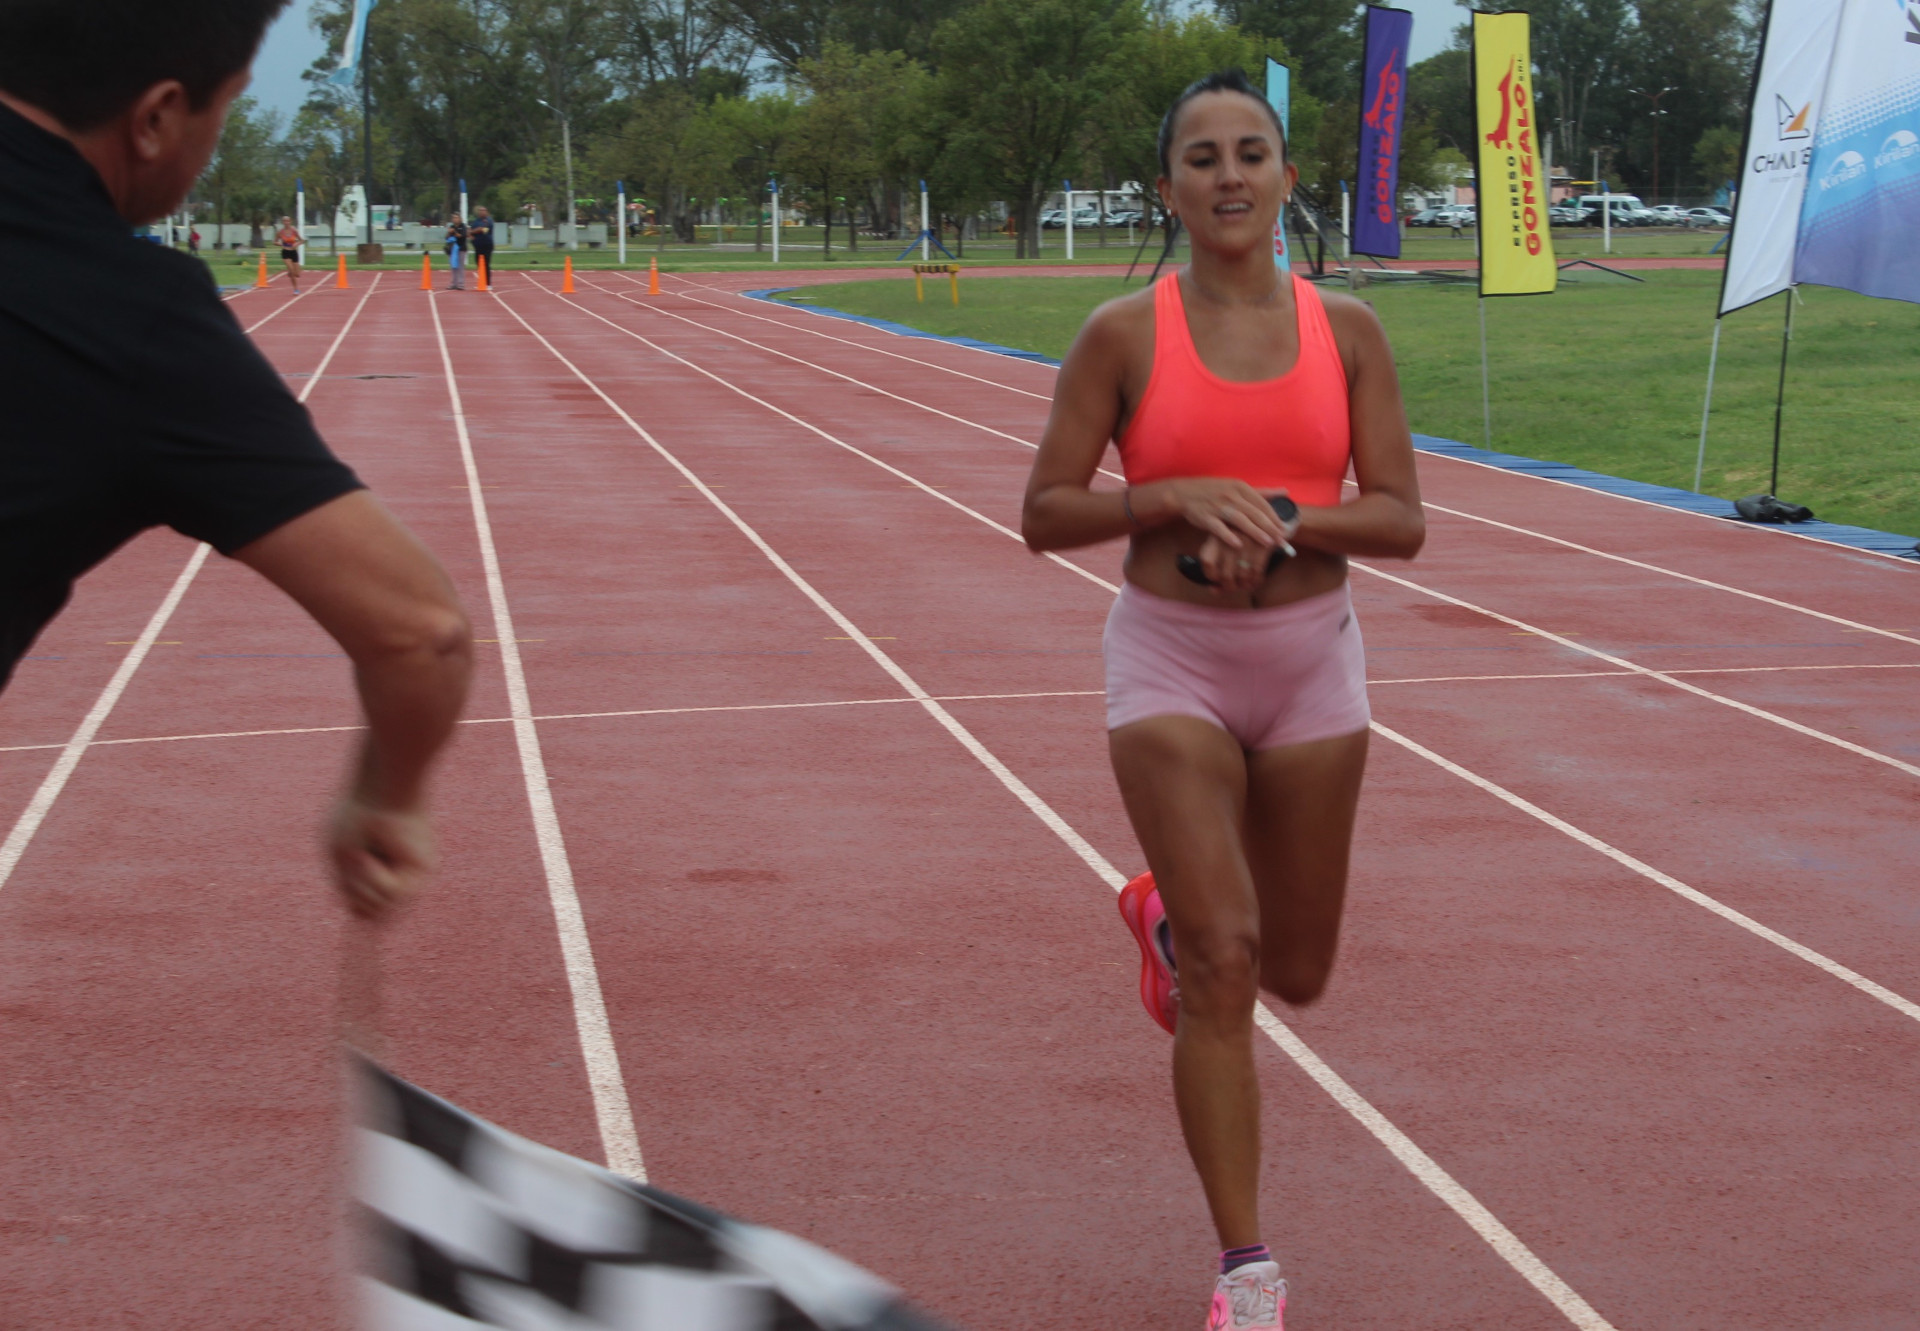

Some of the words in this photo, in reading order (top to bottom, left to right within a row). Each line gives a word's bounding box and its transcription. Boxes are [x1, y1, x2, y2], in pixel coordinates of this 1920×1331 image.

[1376, 72, 1400, 223] GONZALO
[1506, 155, 1521, 247] EXPRESO
[1514, 83, 1543, 256] GONZALO
